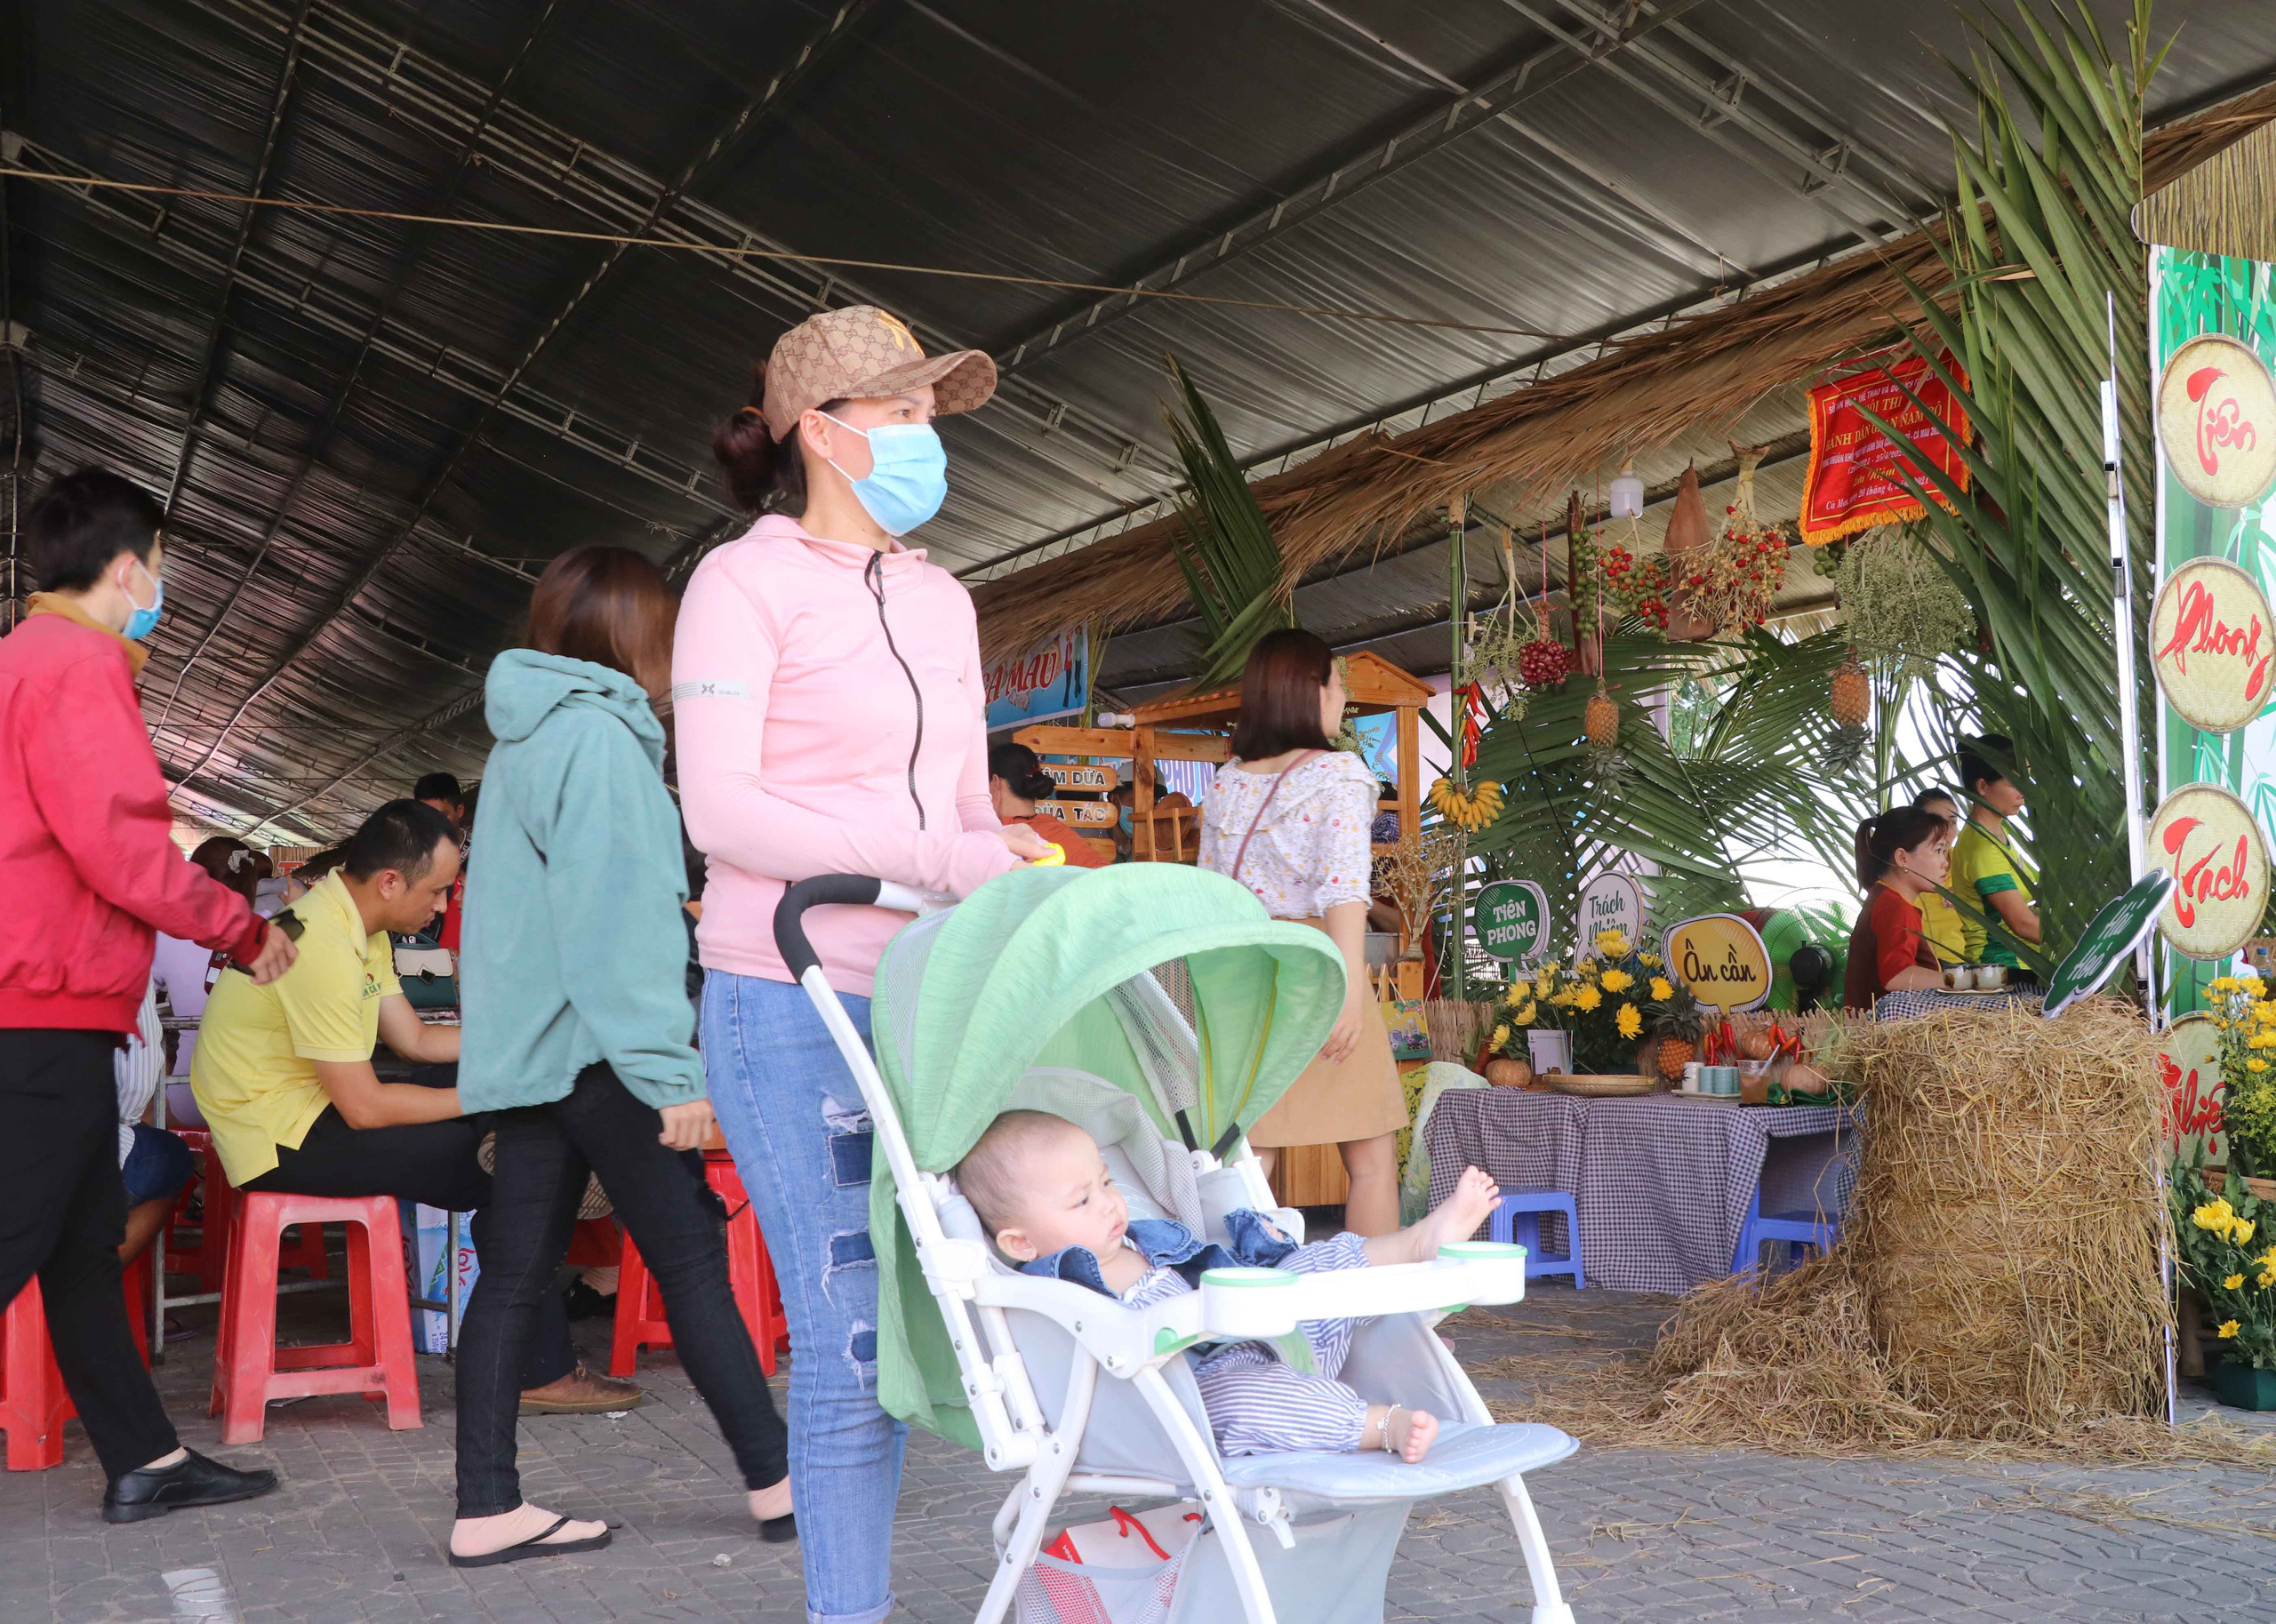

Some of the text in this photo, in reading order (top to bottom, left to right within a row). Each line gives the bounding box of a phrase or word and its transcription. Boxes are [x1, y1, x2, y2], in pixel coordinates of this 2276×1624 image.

[1882, 396, 1903, 412] THI
[1826, 500, 1836, 510] Cà
[1005, 651, 1057, 696] MAU
[1071, 765, 1106, 786] DỪA
[1072, 802, 1106, 822] TẮC
[1589, 890, 1626, 919] Trách
[1487, 920, 1537, 947] PHONG
